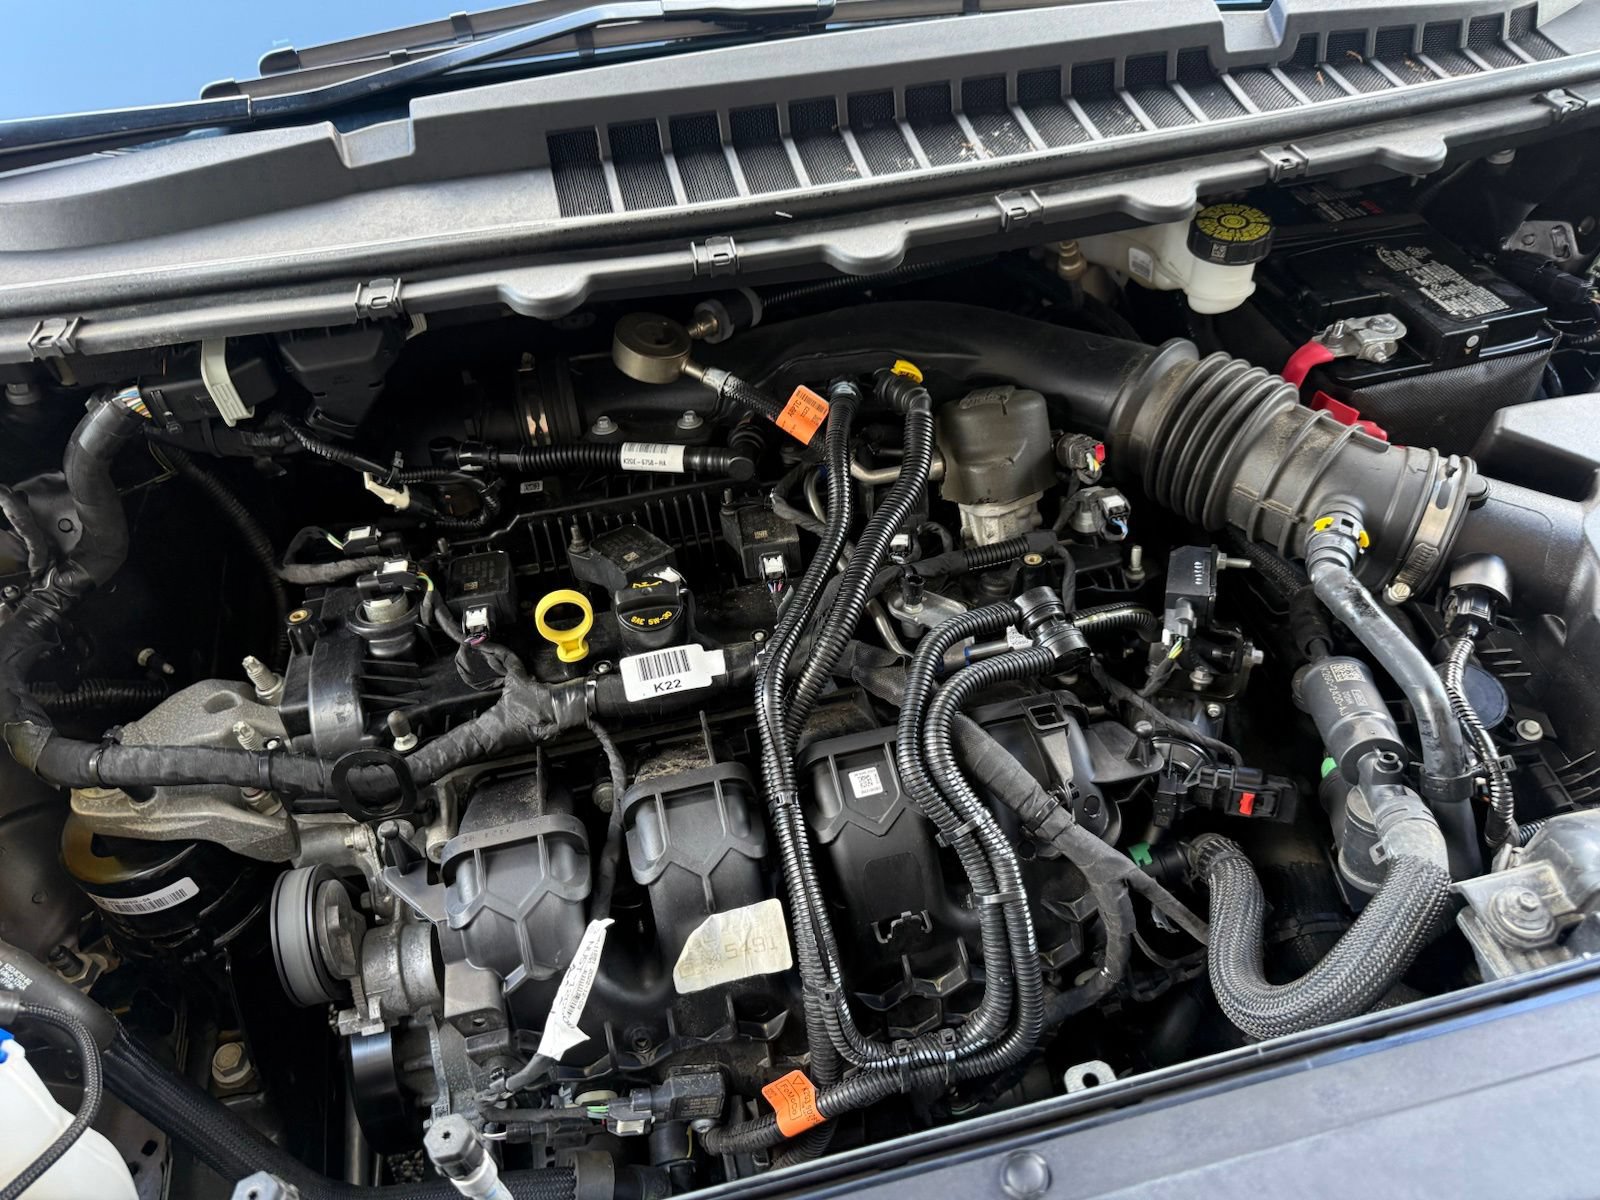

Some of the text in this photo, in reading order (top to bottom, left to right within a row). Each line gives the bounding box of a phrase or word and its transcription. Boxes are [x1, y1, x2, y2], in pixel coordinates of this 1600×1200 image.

[631, 610, 672, 625] SAE 5W-30
[653, 678, 682, 693] K22
[780, 1083, 798, 1116] FoMoCo
